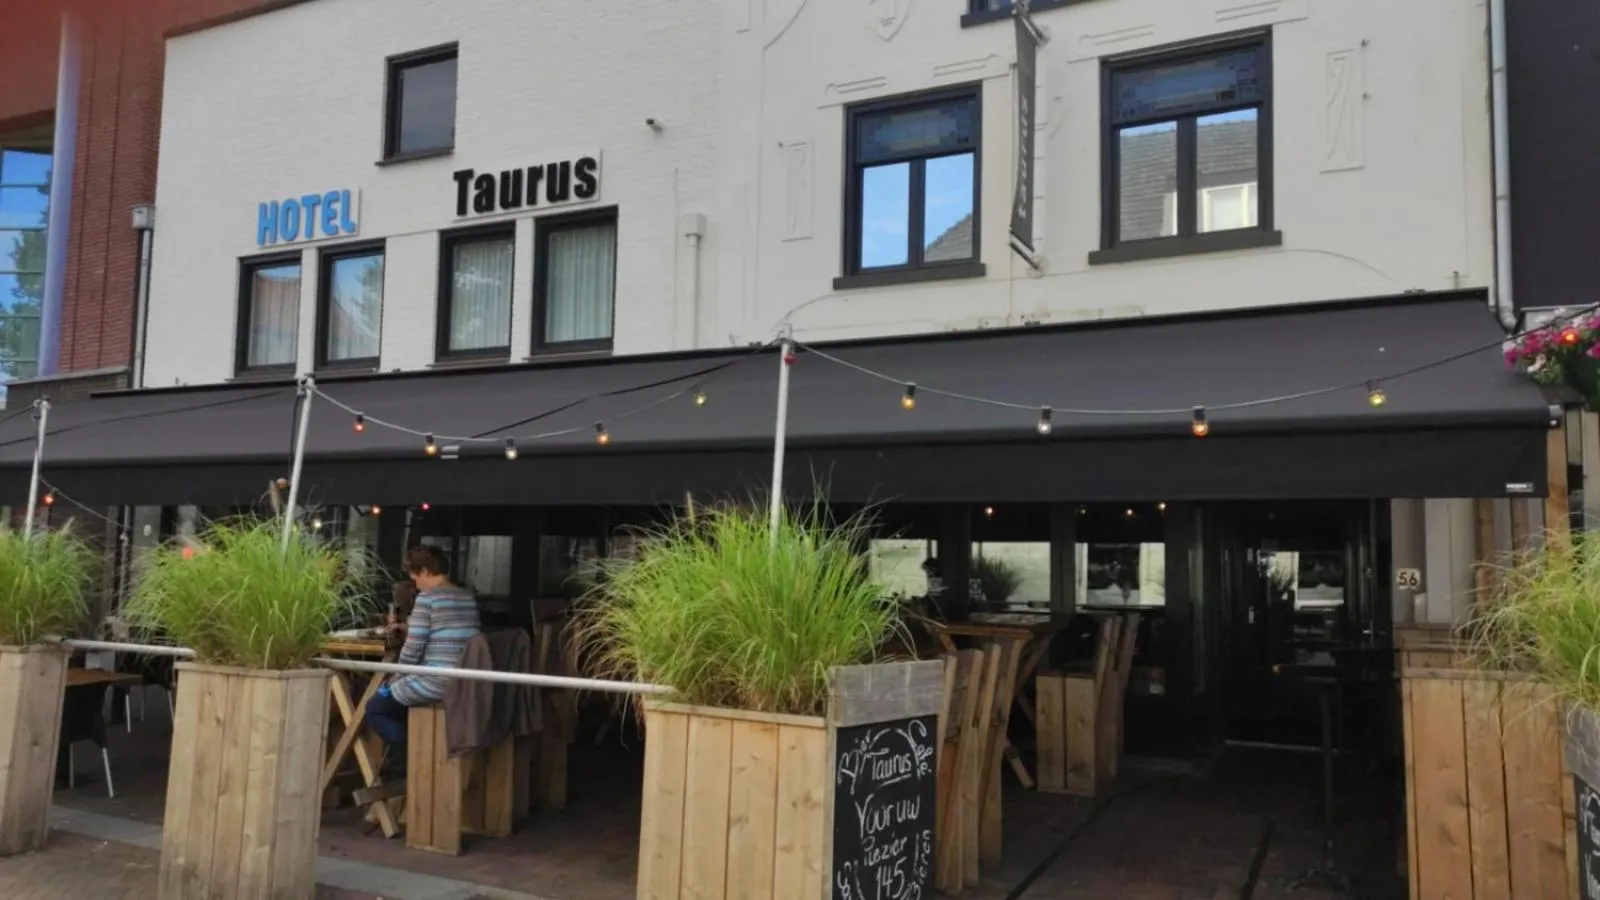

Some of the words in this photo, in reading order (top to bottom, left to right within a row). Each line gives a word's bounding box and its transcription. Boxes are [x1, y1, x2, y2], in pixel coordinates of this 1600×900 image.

[453, 156, 598, 216] Taurus
[256, 188, 357, 247] HOTEL
[1399, 571, 1418, 586] 56
[862, 747, 912, 781] Taurus
[876, 855, 907, 900] 145
